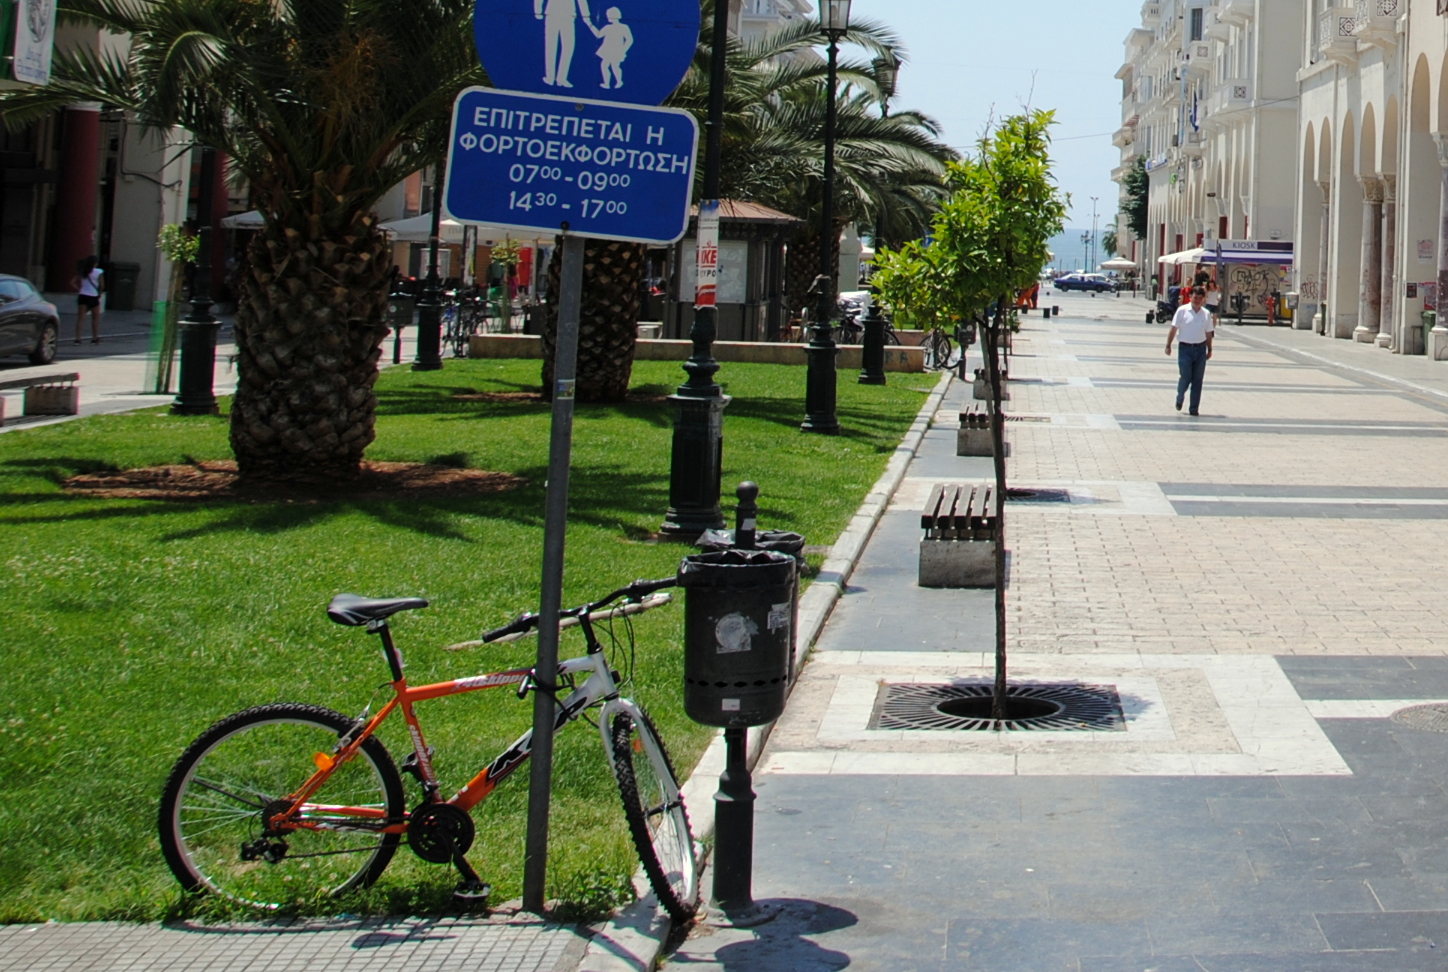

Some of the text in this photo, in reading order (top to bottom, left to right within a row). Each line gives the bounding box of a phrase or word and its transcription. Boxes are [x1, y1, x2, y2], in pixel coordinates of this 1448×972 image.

[473, 106, 665, 146] ΕΠΙΤΡΕΠΕΤΑΙ Η
[459, 132, 689, 175] ΦΟΡΤΟΕΚΦΟΡΤΩΣΗ
[1232, 241, 1256, 249] KIOSK
